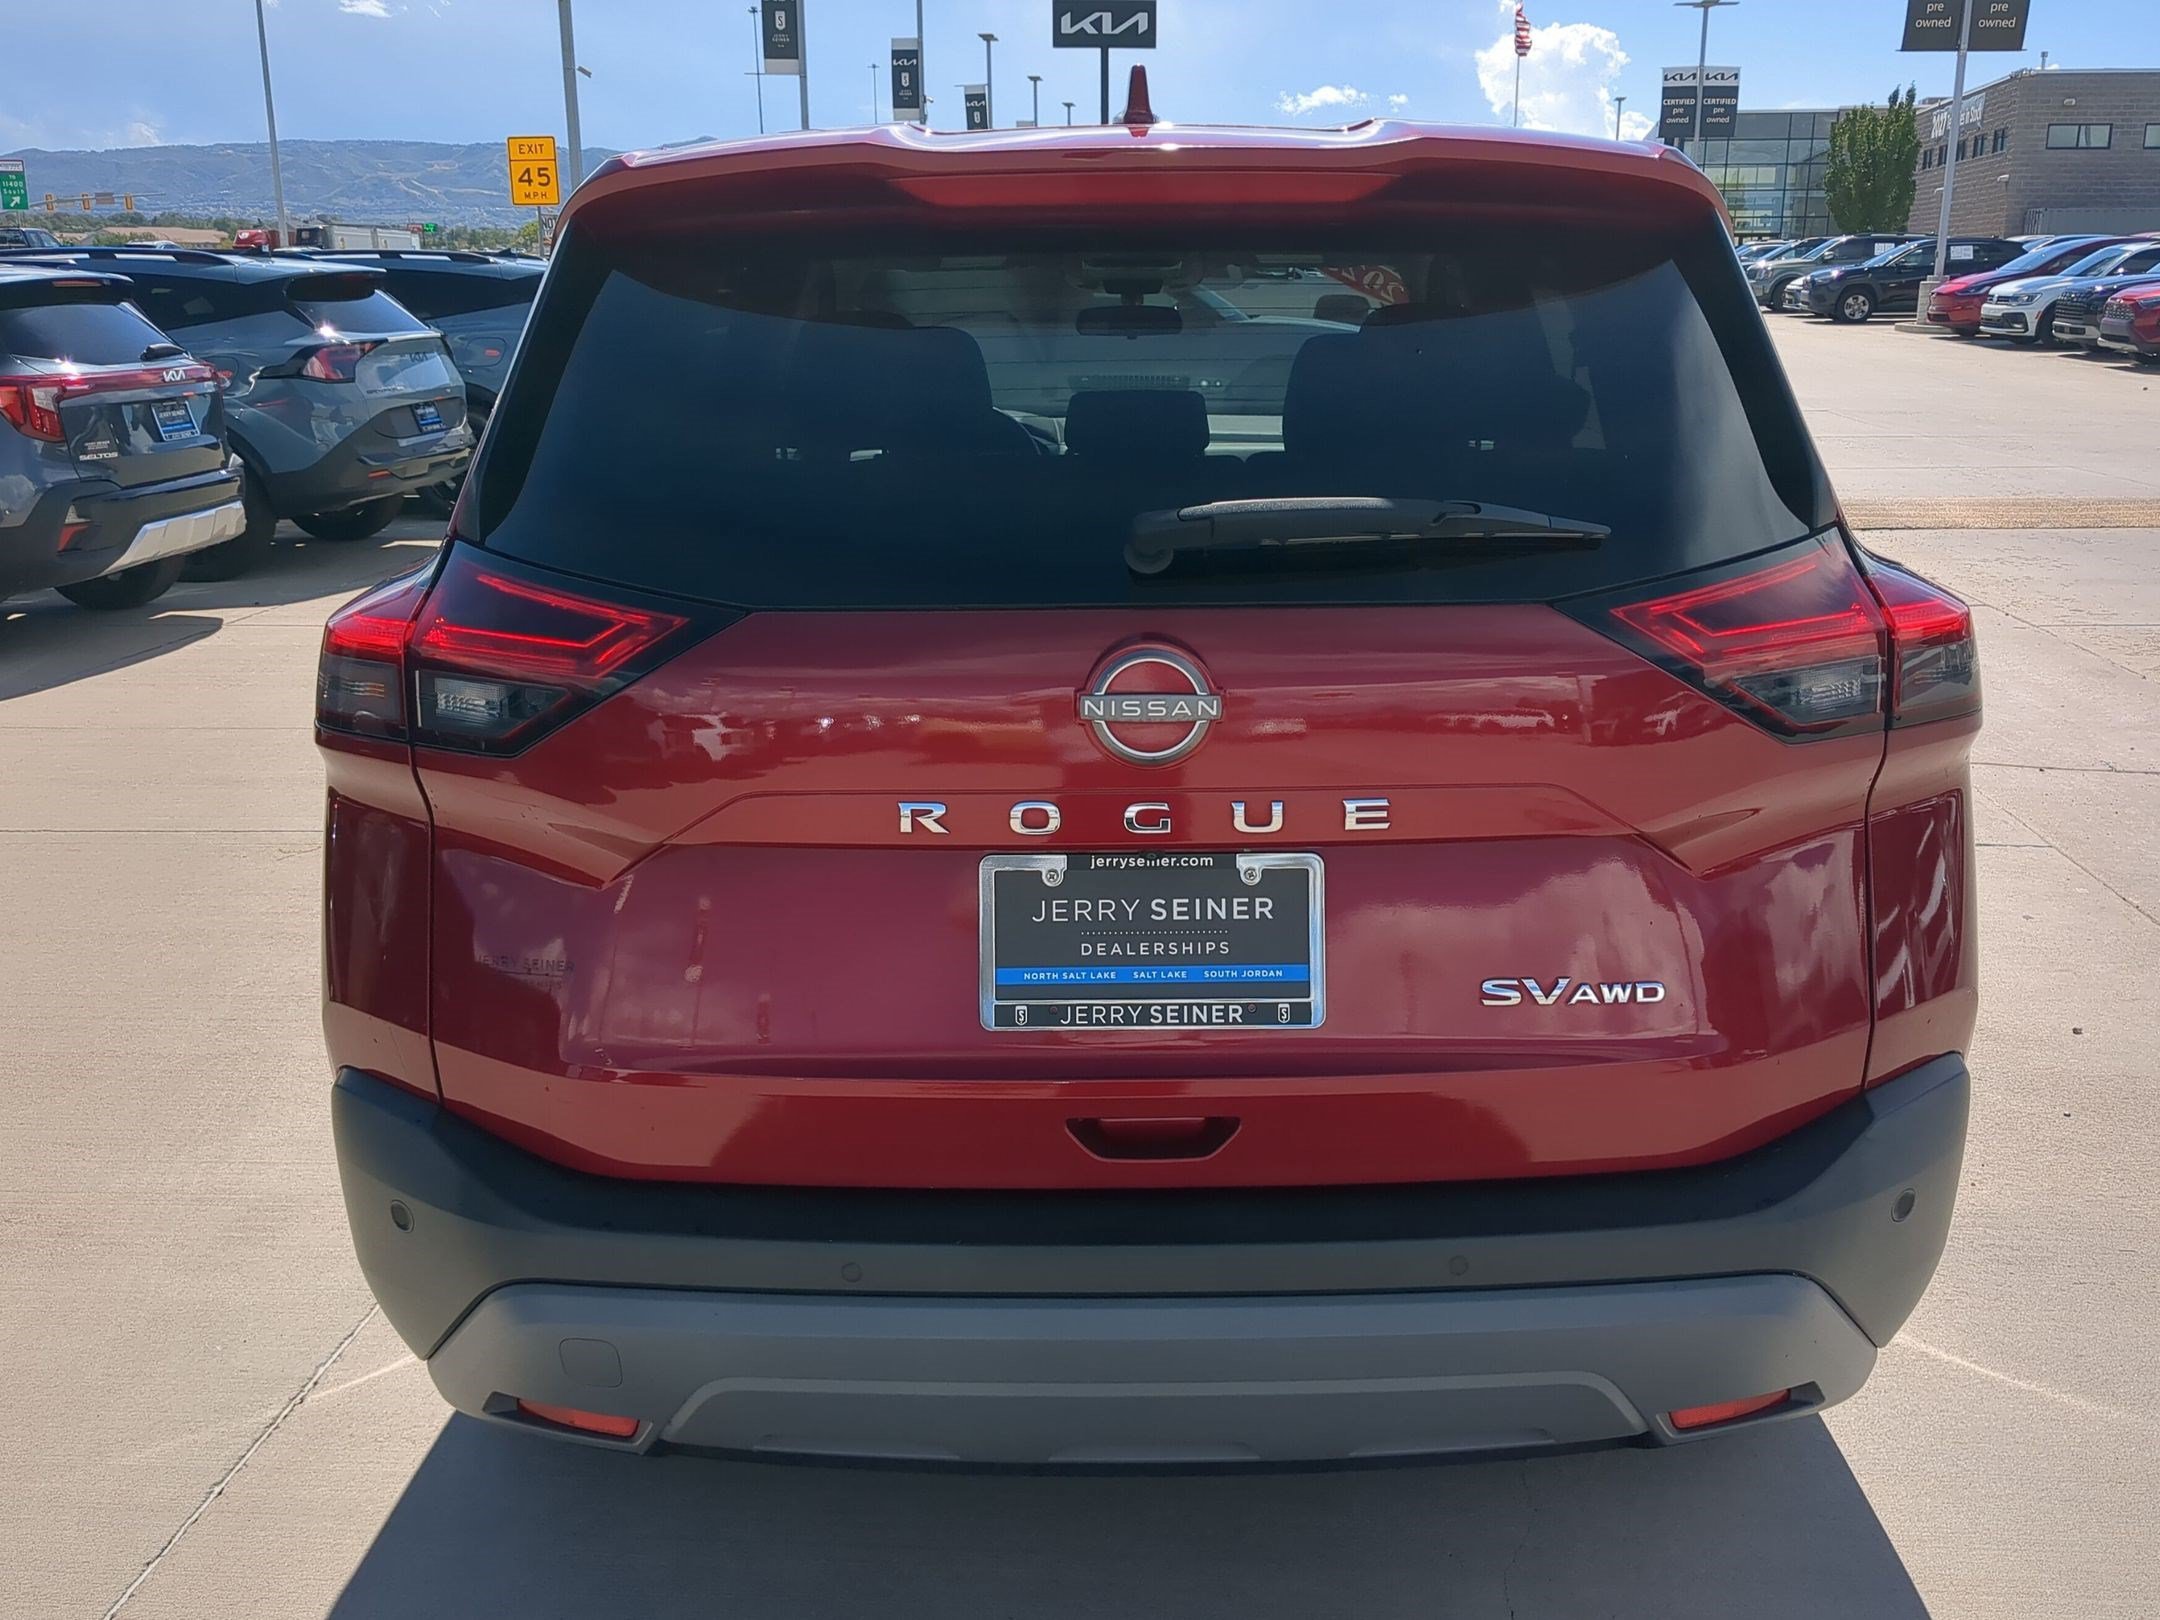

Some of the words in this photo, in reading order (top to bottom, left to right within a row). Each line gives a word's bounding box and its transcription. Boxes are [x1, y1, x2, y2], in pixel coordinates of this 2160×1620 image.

[1926, 2, 1945, 13] pre
[1990, 2, 2009, 13] pre
[1060, 11, 1149, 35] KIA
[1915, 17, 1952, 28] owned
[1978, 17, 2017, 28] owned
[1663, 98, 1696, 106] CERTIFIED
[1673, 107, 1685, 115] pre
[1713, 107, 1725, 115] pre
[1666, 116, 1690, 124] owned
[1706, 116, 1730, 124] owned
[518, 144, 544, 154] EXIT
[518, 167, 551, 187] 45
[1084, 700, 1217, 716] NISSAN
[898, 799, 1391, 835] ROGUE
[1032, 899, 1140, 922] JERRY
[1150, 897, 1274, 920] SEINER
[1081, 942, 1230, 956] DEALERSHIPS
[1024, 972, 1059, 980] NORTH
[1062, 972, 1087, 980] SALT
[1090, 971, 1117, 979] LAKE
[1133, 971, 1158, 979] SALT
[1161, 970, 1187, 978] LAKE
[1204, 970, 1238, 978] SOUTH
[1241, 969, 1283, 978] JORDAN
[1568, 982, 1665, 1004] AWD
[1060, 1005, 1141, 1025] JERRY
[1150, 1004, 1243, 1024] SEINER
